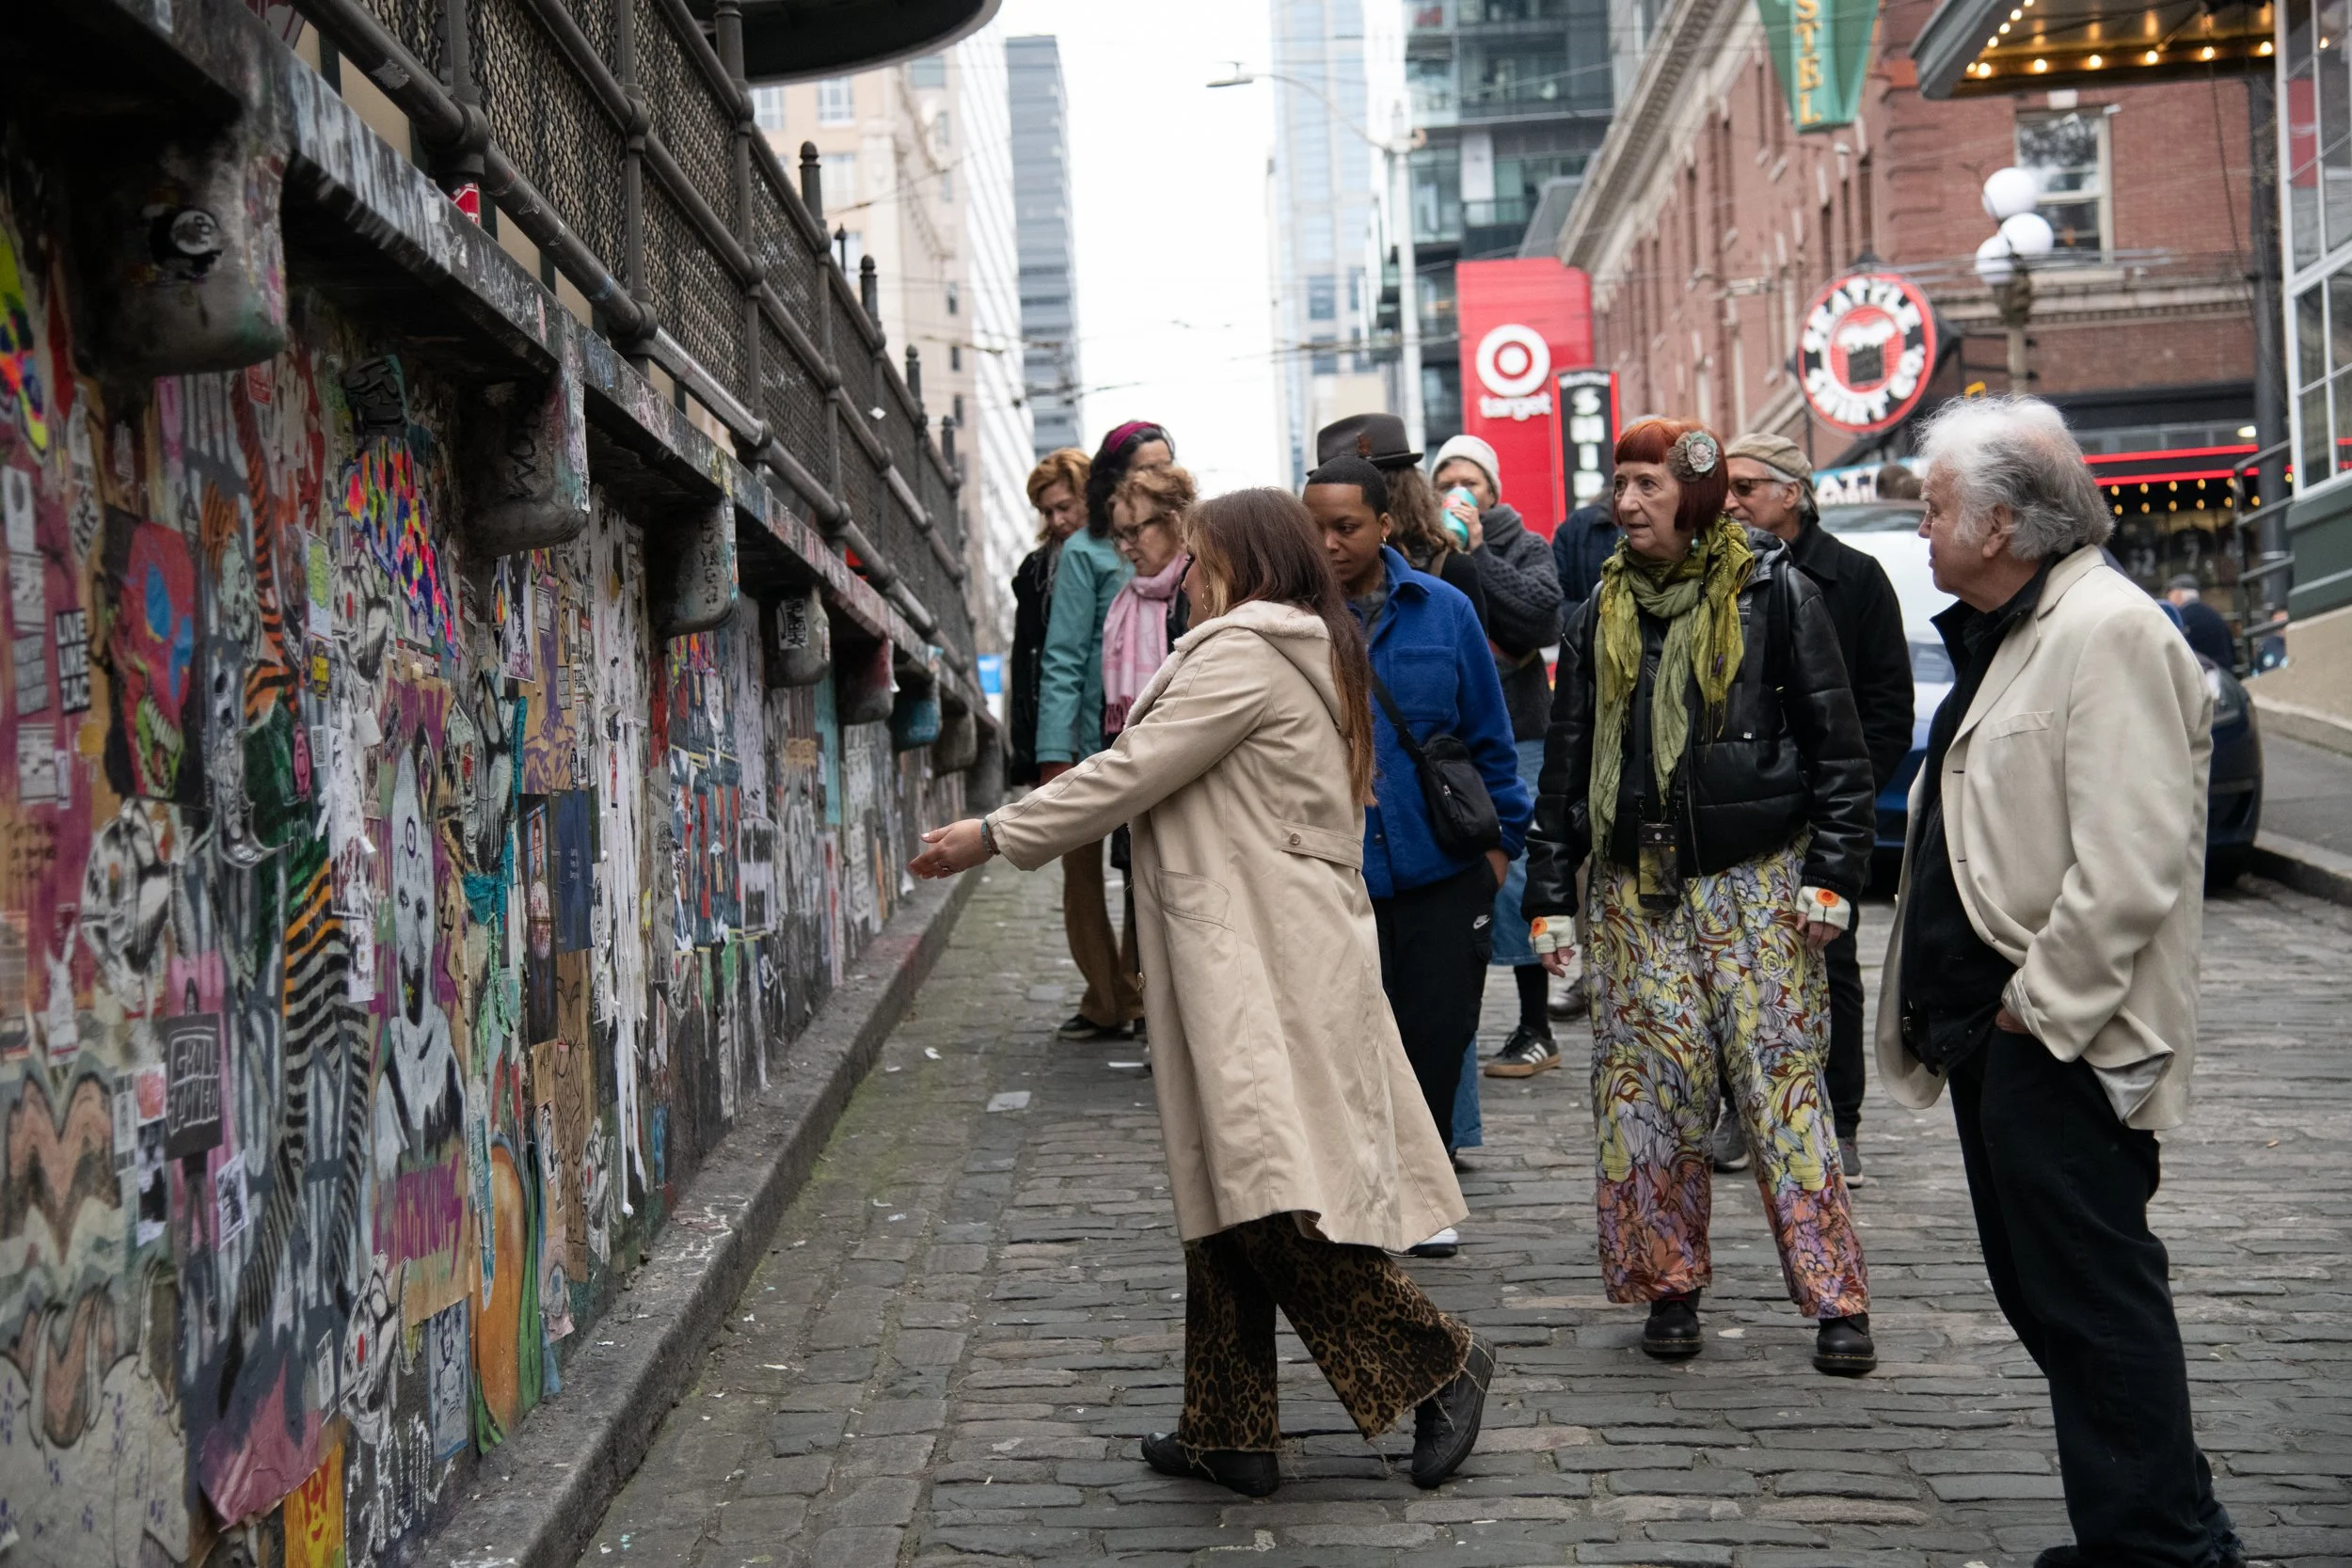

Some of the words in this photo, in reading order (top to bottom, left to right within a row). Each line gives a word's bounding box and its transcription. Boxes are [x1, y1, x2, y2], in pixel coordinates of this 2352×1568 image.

[1803, 277, 1922, 353] SEATTLE
[1479, 391, 1552, 421] target
[1806, 368, 1889, 424] SHIRT
[56, 612, 87, 644] LIVE
[58, 645, 89, 678] LIKE
